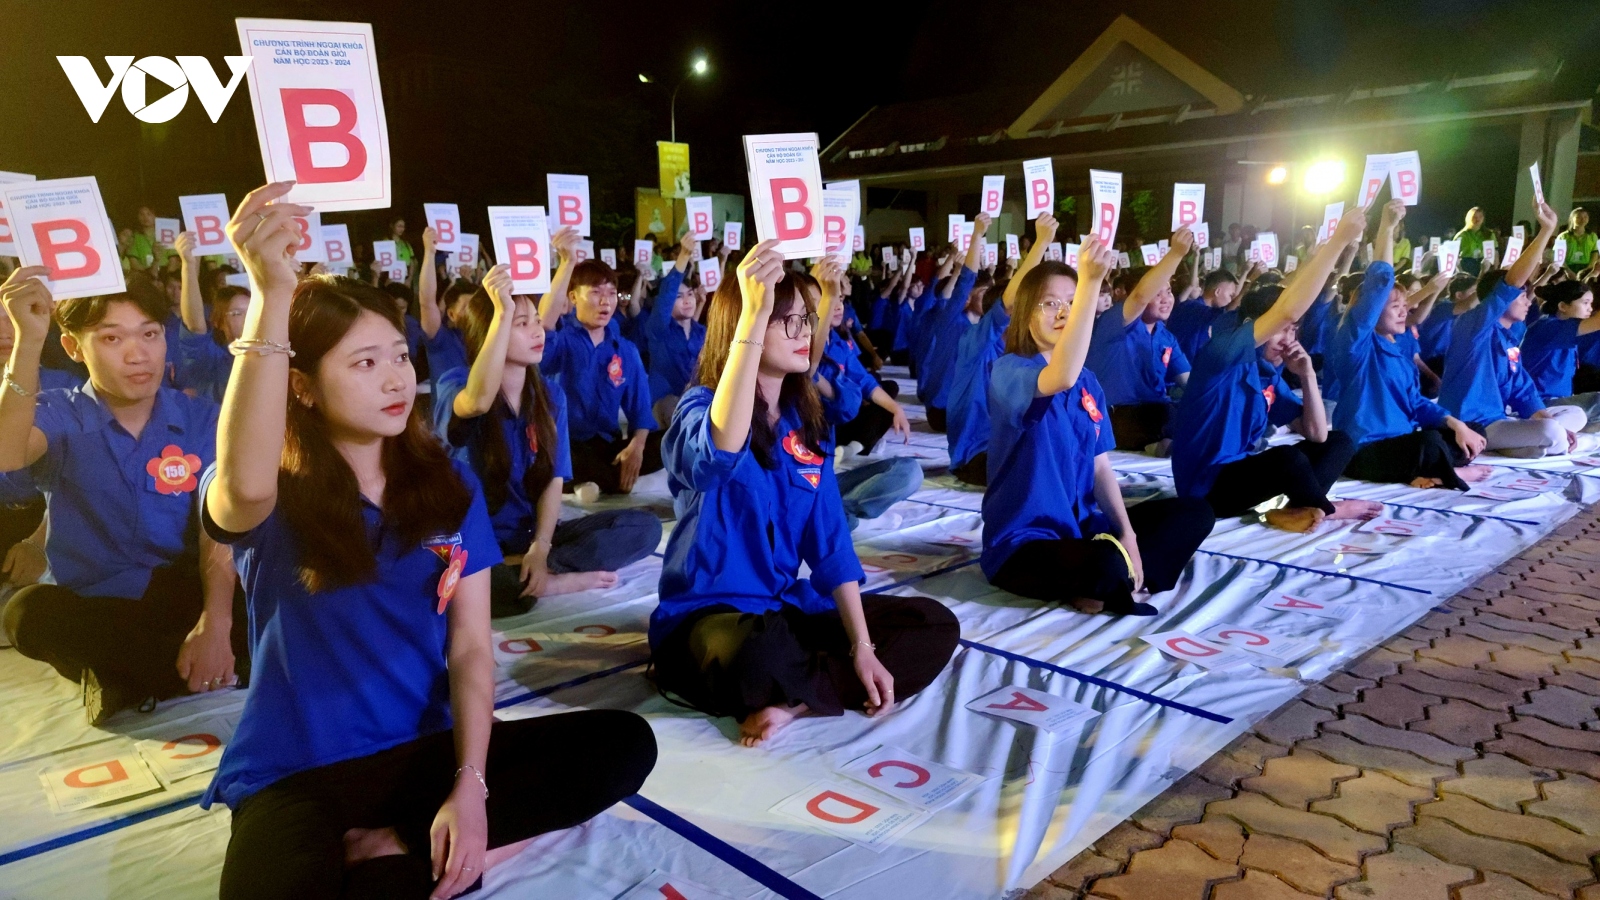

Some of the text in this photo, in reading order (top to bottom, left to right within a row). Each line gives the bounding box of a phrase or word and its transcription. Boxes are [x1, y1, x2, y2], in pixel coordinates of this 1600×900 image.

[279, 87, 368, 185] B
[1032, 178, 1051, 210] B
[1397, 170, 1417, 197] B
[558, 195, 583, 226] B
[769, 177, 813, 242] B
[987, 190, 999, 212] B
[694, 212, 709, 234] B
[1180, 201, 1197, 225] B
[161, 228, 176, 244] B
[194, 215, 225, 246] B
[435, 219, 455, 244] B
[728, 231, 737, 245] B
[1198, 232, 1206, 245] B
[31, 218, 102, 282] B
[325, 240, 345, 262] B
[914, 236, 922, 247] B
[1010, 243, 1017, 255] B
[380, 252, 392, 266] B
[459, 245, 473, 262] B
[505, 237, 540, 281] B
[638, 249, 648, 262] B
[989, 251, 996, 262] B
[393, 269, 402, 280] B
[705, 270, 718, 287] B
[164, 464, 186, 478] 158
[1273, 595, 1324, 609] A
[574, 624, 616, 638] C
[1218, 629, 1270, 646] C
[498, 637, 543, 654] D
[1166, 637, 1223, 657] D
[985, 691, 1050, 712] A
[161, 733, 222, 759] C
[63, 759, 129, 788] D
[867, 760, 931, 789] C
[806, 789, 881, 824] D
